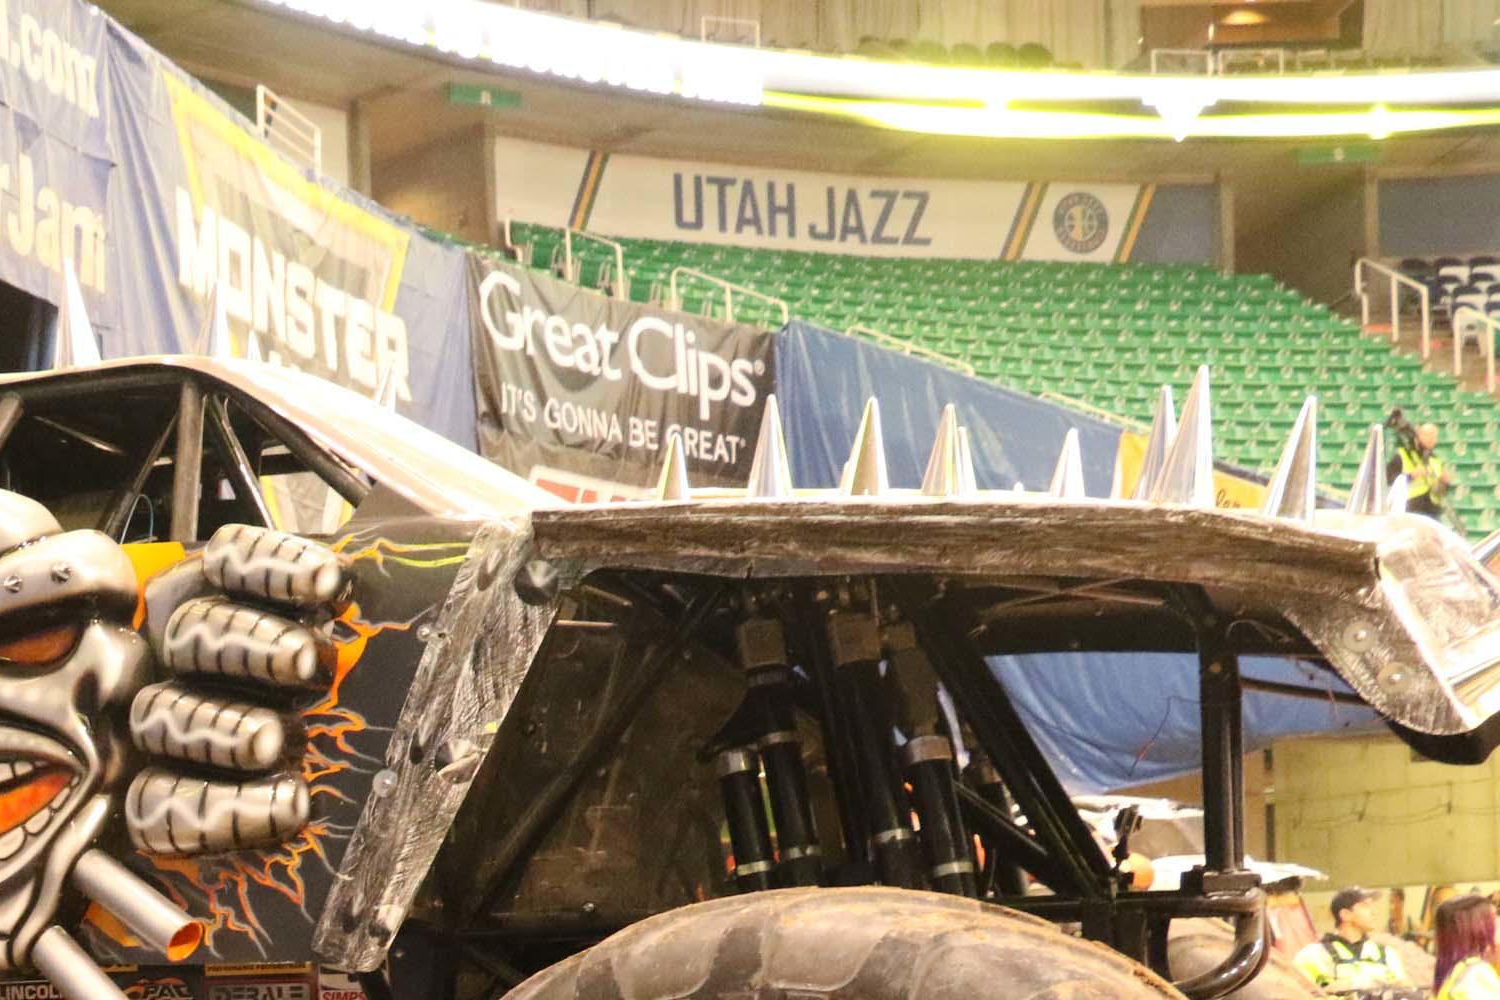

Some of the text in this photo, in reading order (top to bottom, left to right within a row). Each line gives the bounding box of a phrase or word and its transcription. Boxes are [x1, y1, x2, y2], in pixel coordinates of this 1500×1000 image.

[674, 172, 932, 247] UTAH JAZZ
[176, 183, 412, 402] MONSTER
[480, 271, 622, 381] Great
[501, 383, 536, 424] IT'S
[543, 397, 623, 443] GONNA
[628, 416, 659, 450] BE
